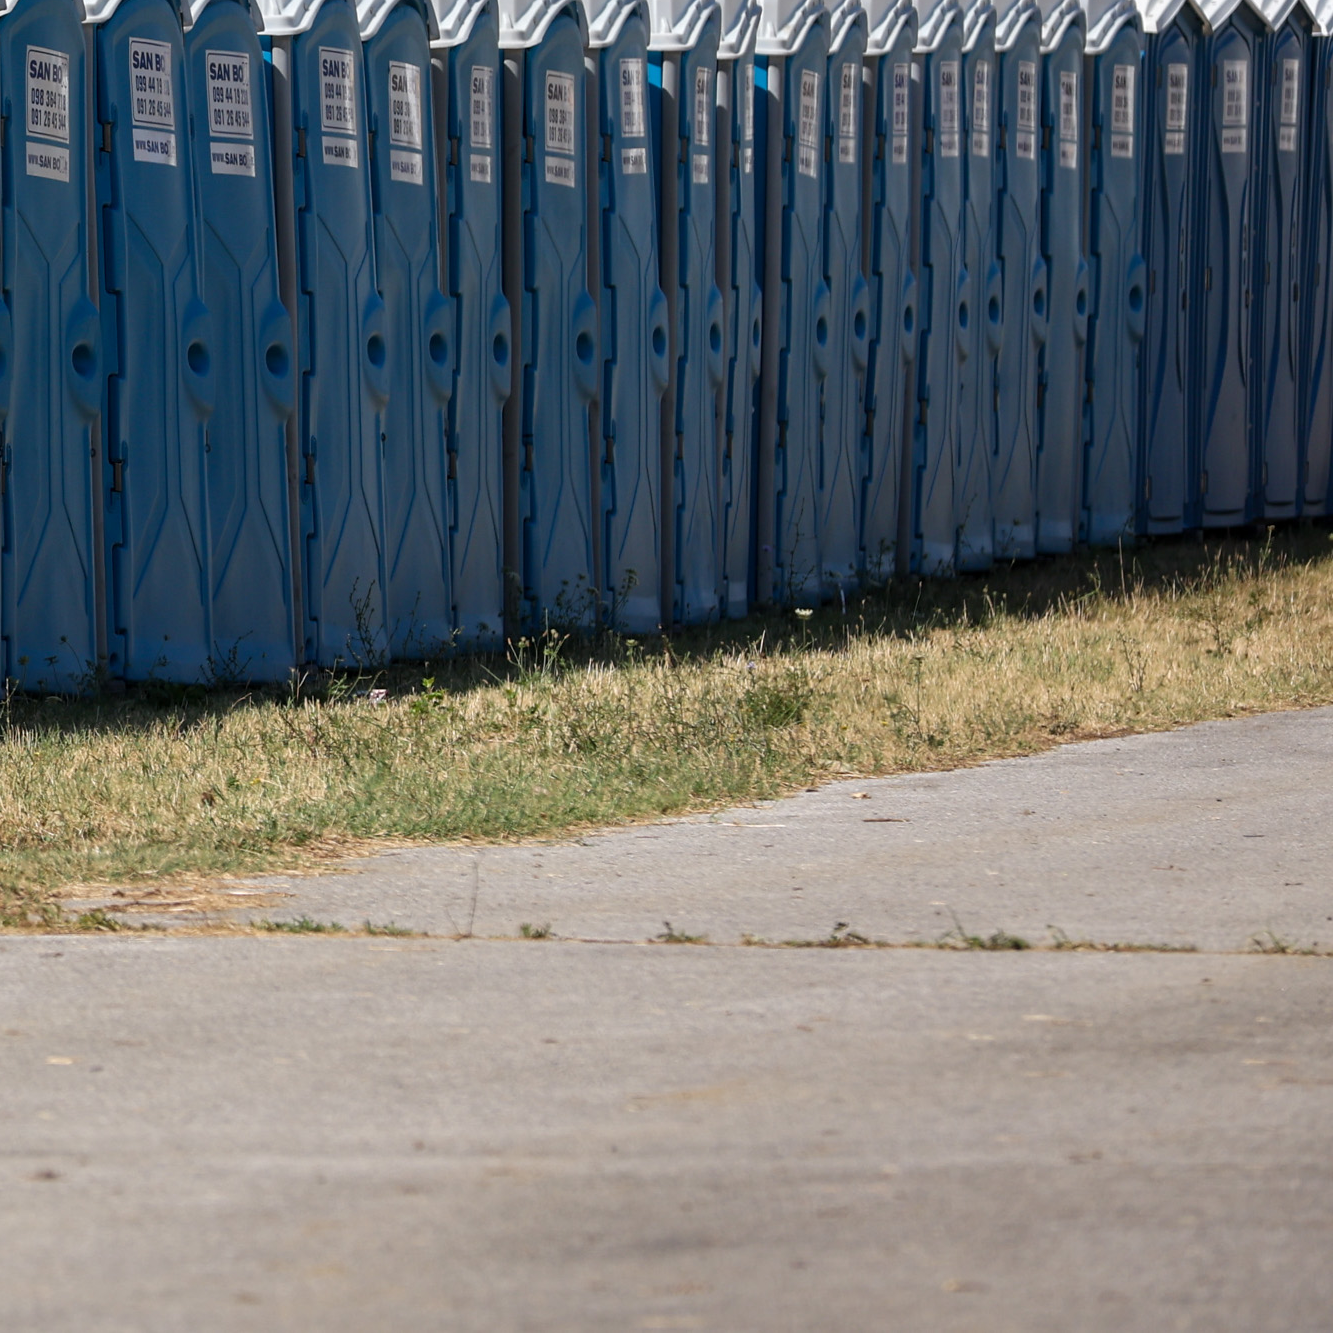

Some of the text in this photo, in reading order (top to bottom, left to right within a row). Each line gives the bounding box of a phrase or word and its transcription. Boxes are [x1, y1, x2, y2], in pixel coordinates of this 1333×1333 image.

[133, 51, 153, 70] SAN
[323, 59, 339, 77] SAN
[30, 60, 50, 81] SAN
[210, 63, 230, 81] SAN
[136, 75, 146, 92] 099
[392, 74, 407, 92] SAN
[548, 83, 562, 101] SAN
[31, 88, 44, 106] 098
